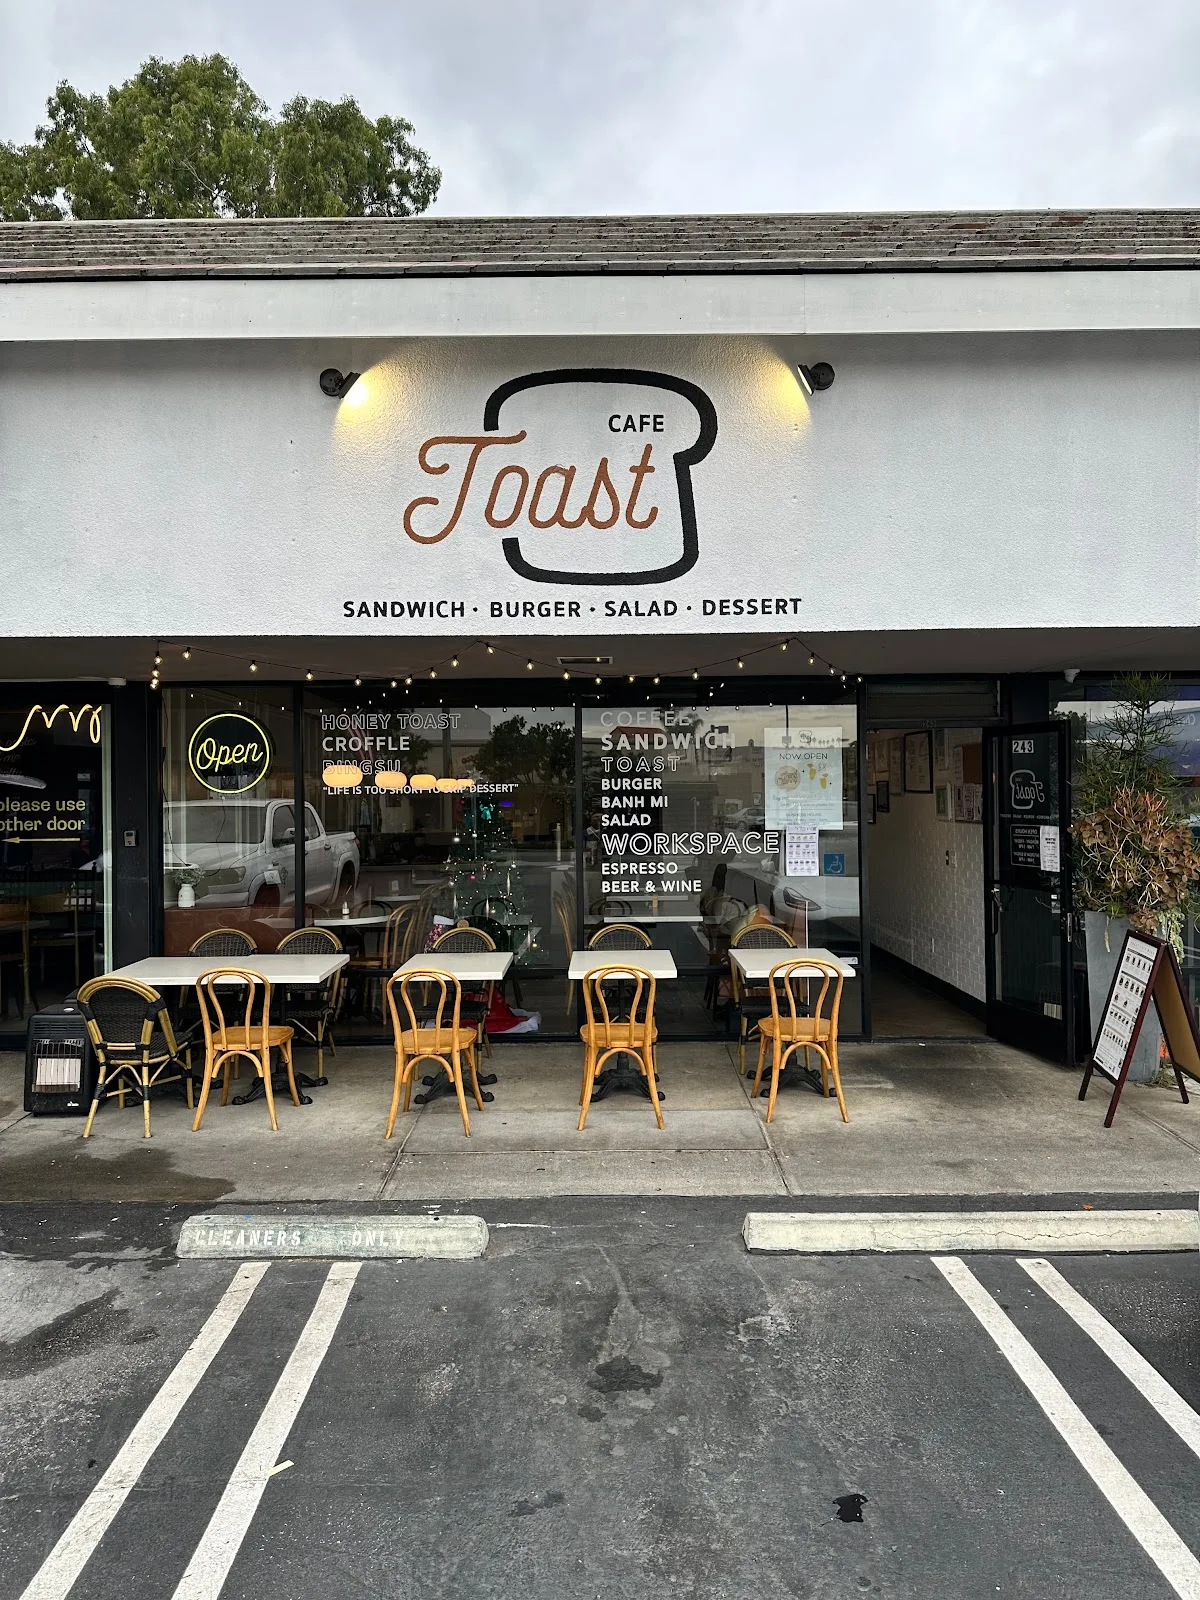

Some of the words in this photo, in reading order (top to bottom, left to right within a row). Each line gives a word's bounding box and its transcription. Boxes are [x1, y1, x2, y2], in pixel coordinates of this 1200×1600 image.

[607, 413, 665, 433] CAFE
[403, 429, 659, 545] Toast
[342, 600, 466, 619] SANDWICH
[489, 600, 581, 618] BURGER
[604, 599, 678, 618] SALAD
[702, 597, 803, 616] DESSERT
[321, 713, 391, 731] HONEY
[397, 713, 461, 730] TOAST
[600, 711, 690, 727] COFFEE
[322, 736, 410, 752] CROFFLE
[601, 732, 737, 751] SANDWICH
[1013, 740, 1033, 753] 243
[196, 737, 263, 772] Open
[804, 752, 828, 760] OPEN
[322, 759, 401, 776] BINGSU
[601, 755, 680, 773] TOAST
[353, 785, 362, 795] IS
[364, 785, 387, 795] TOO
[601, 777, 662, 791] BURGER
[55, 799, 86, 812] use
[601, 796, 645, 808] BANH
[650, 795, 668, 808] MI
[46, 815, 86, 831] door
[601, 813, 652, 827] SALAD
[601, 831, 780, 856] WORKSPACE
[601, 862, 678, 875] ESPRESSO
[601, 880, 640, 893] BEER
[645, 880, 656, 893] &
[661, 879, 702, 892] WINE
[195, 1229, 301, 1247] CLEANERS
[351, 1230, 403, 1247] ONLY
